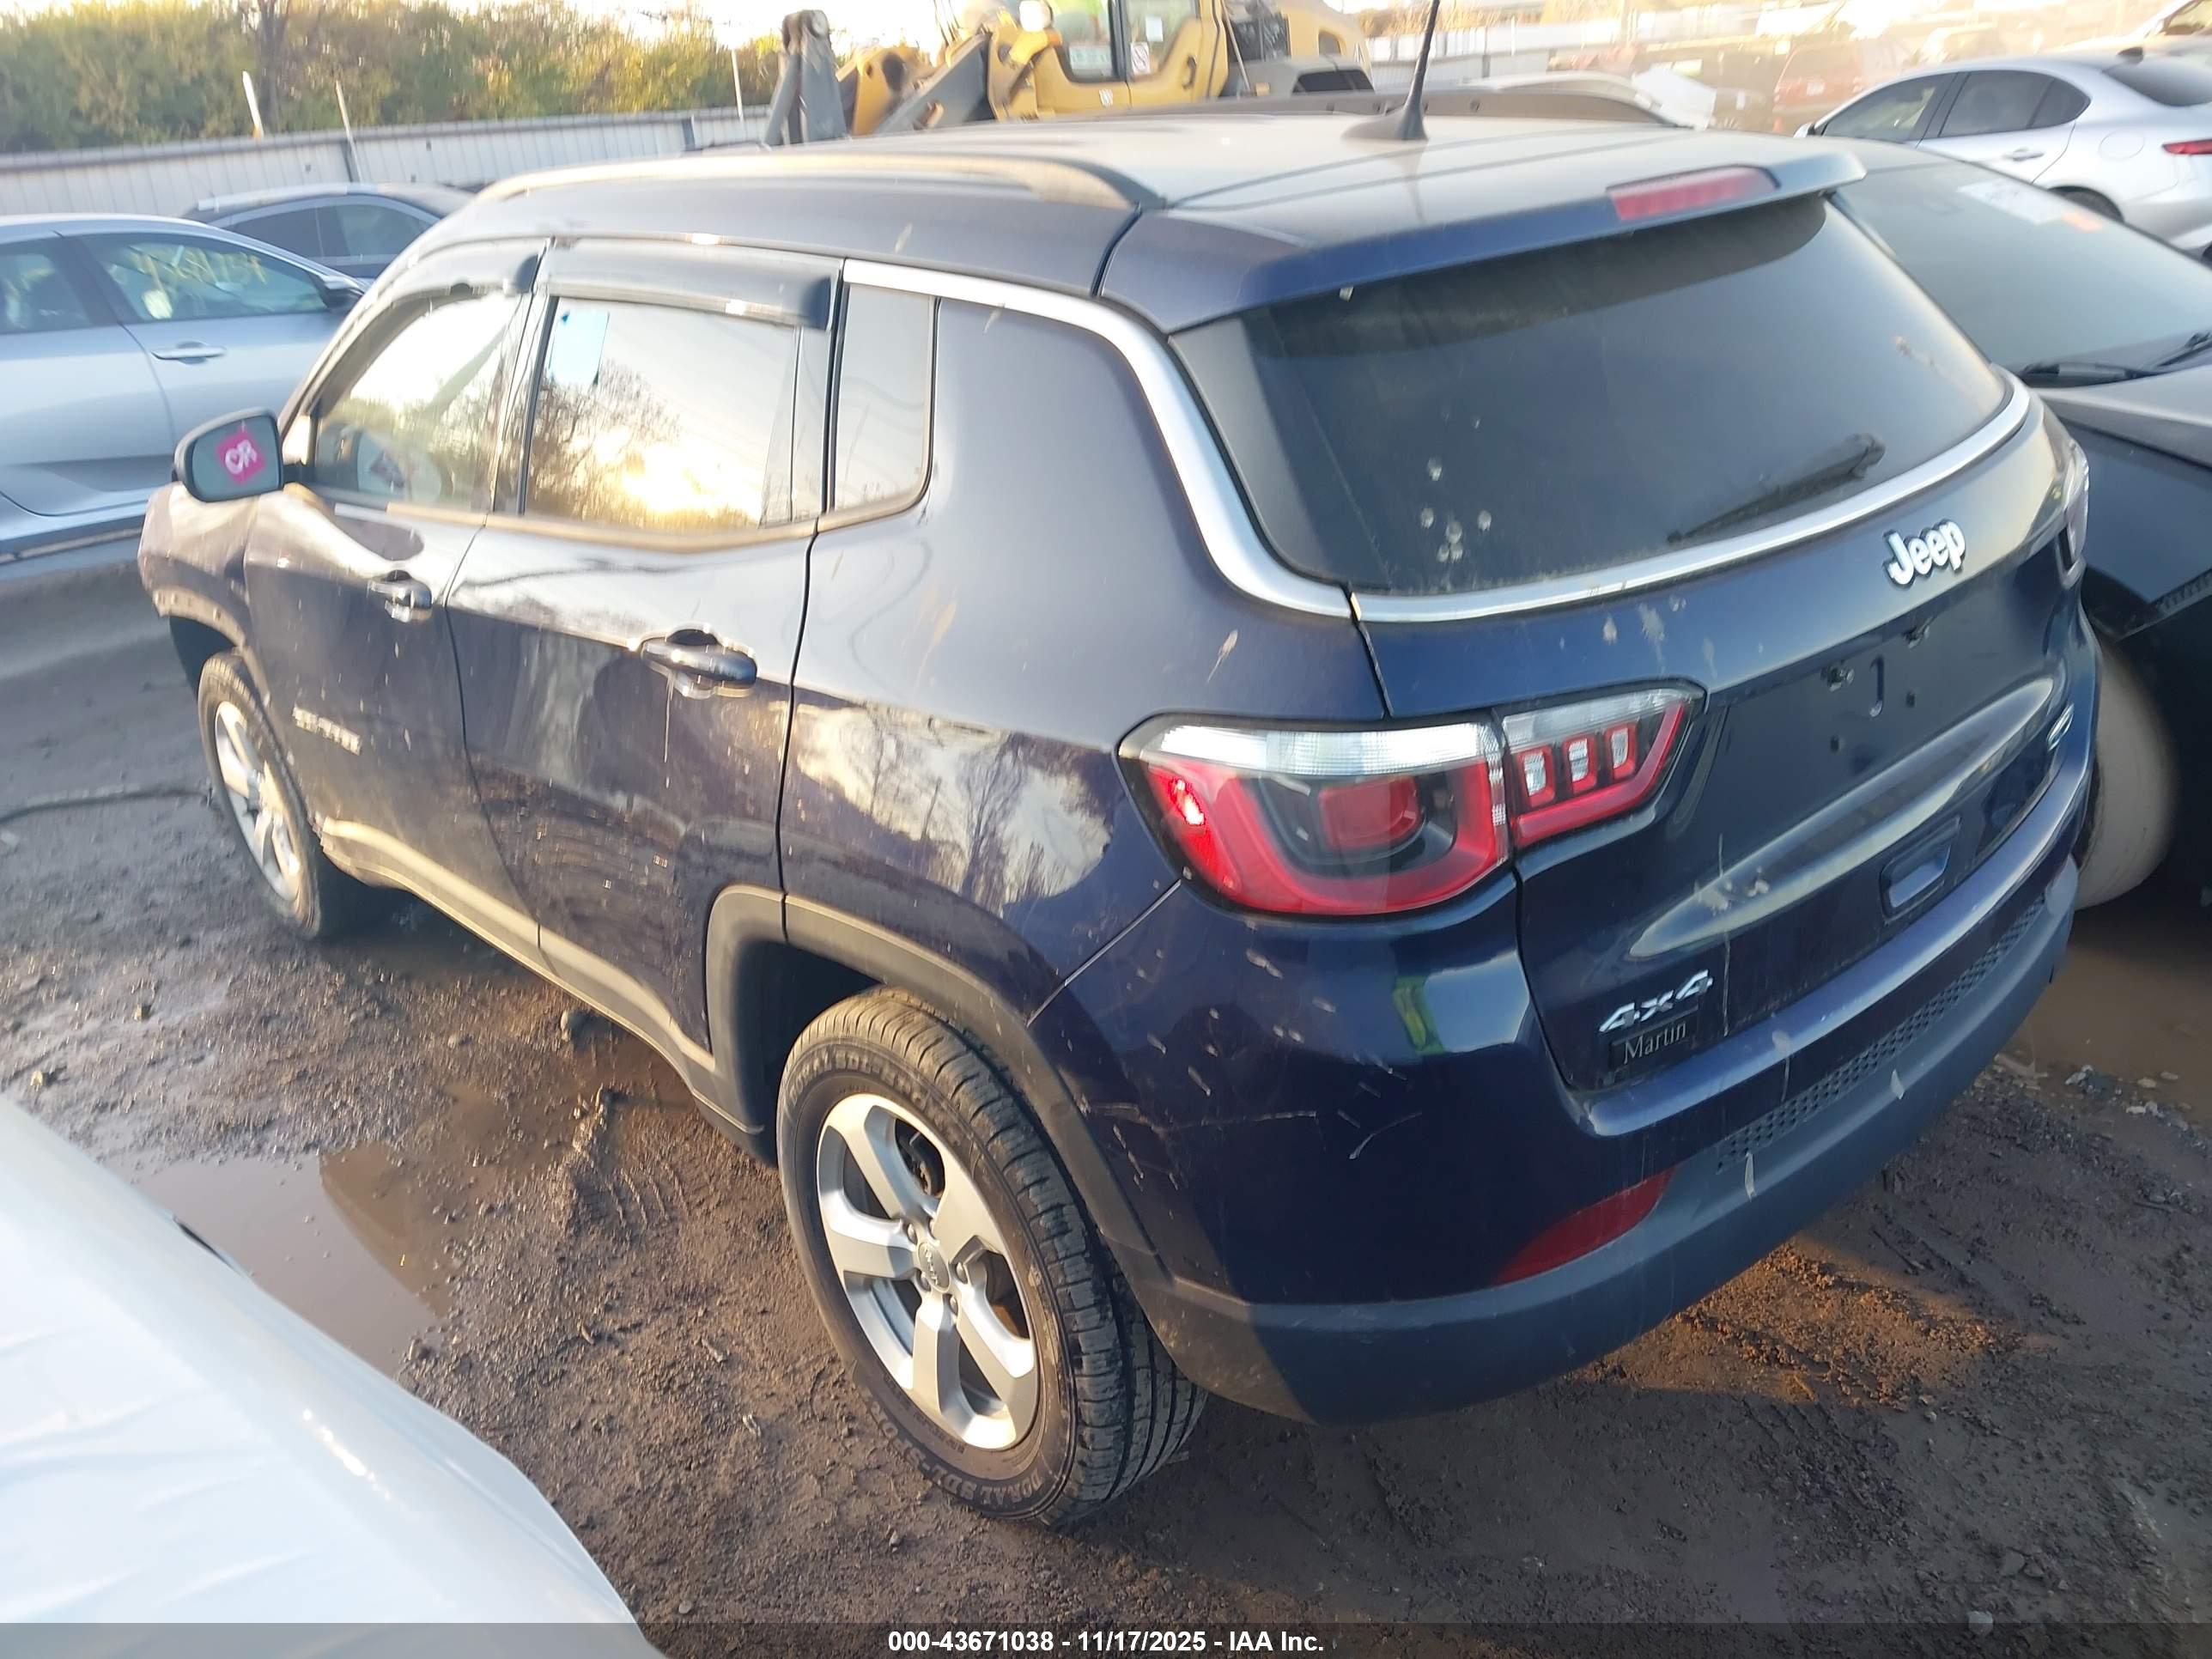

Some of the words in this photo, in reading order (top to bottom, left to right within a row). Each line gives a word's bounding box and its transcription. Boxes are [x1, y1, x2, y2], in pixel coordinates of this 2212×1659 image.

[1885, 520, 1966, 587] Jeep
[1599, 969, 1713, 1032] 4x4
[1623, 1020, 1686, 1065] Martin
[980, 1468, 1044, 1505] DORAL
